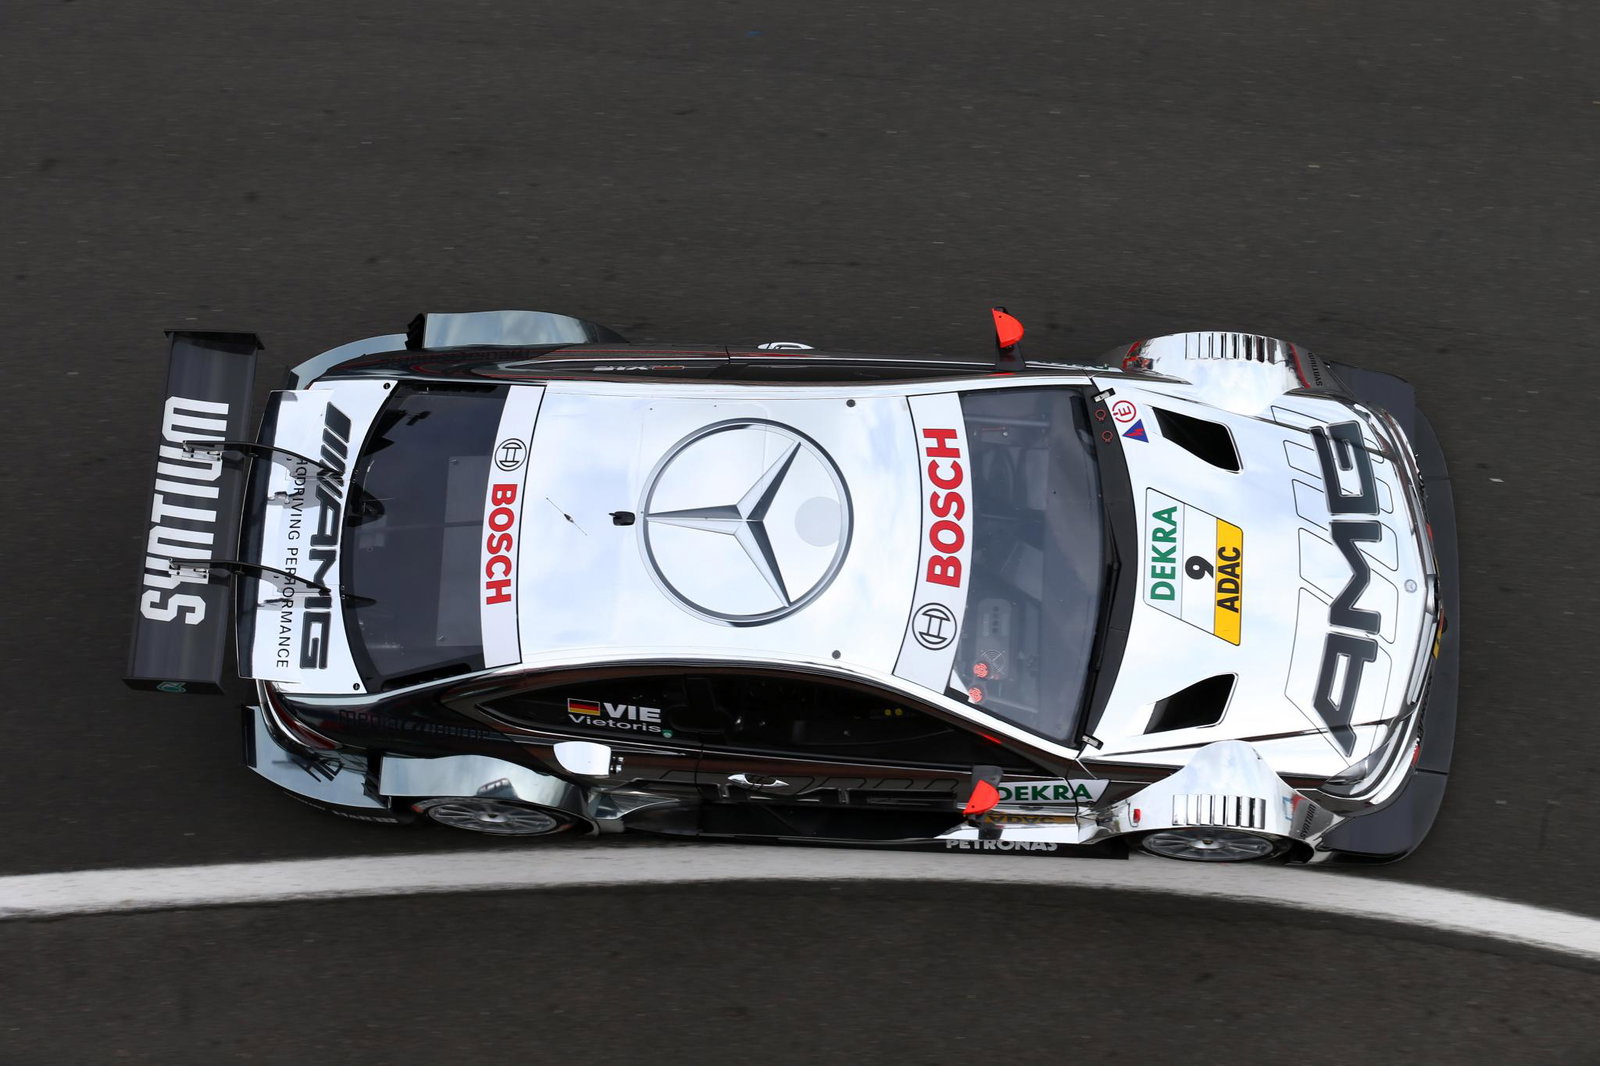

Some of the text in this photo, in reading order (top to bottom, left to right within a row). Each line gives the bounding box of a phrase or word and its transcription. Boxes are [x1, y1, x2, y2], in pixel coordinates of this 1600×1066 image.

[140, 397, 230, 625] SYNTIUM
[485, 484, 518, 605] BOSCH
[923, 429, 965, 588] BOSCH
[275, 476, 307, 669] DRIVING PERORMANCE
[1151, 507, 1178, 600] DEKRA
[1185, 556, 1212, 579] 9
[1217, 546, 1242, 613] ADAC
[1310, 420, 1382, 759] AMG
[568, 713, 662, 733] Vietoris
[603, 702, 661, 723] VIE
[997, 783, 1092, 801] DEKRA
[946, 839, 1058, 851] PETRONAS
